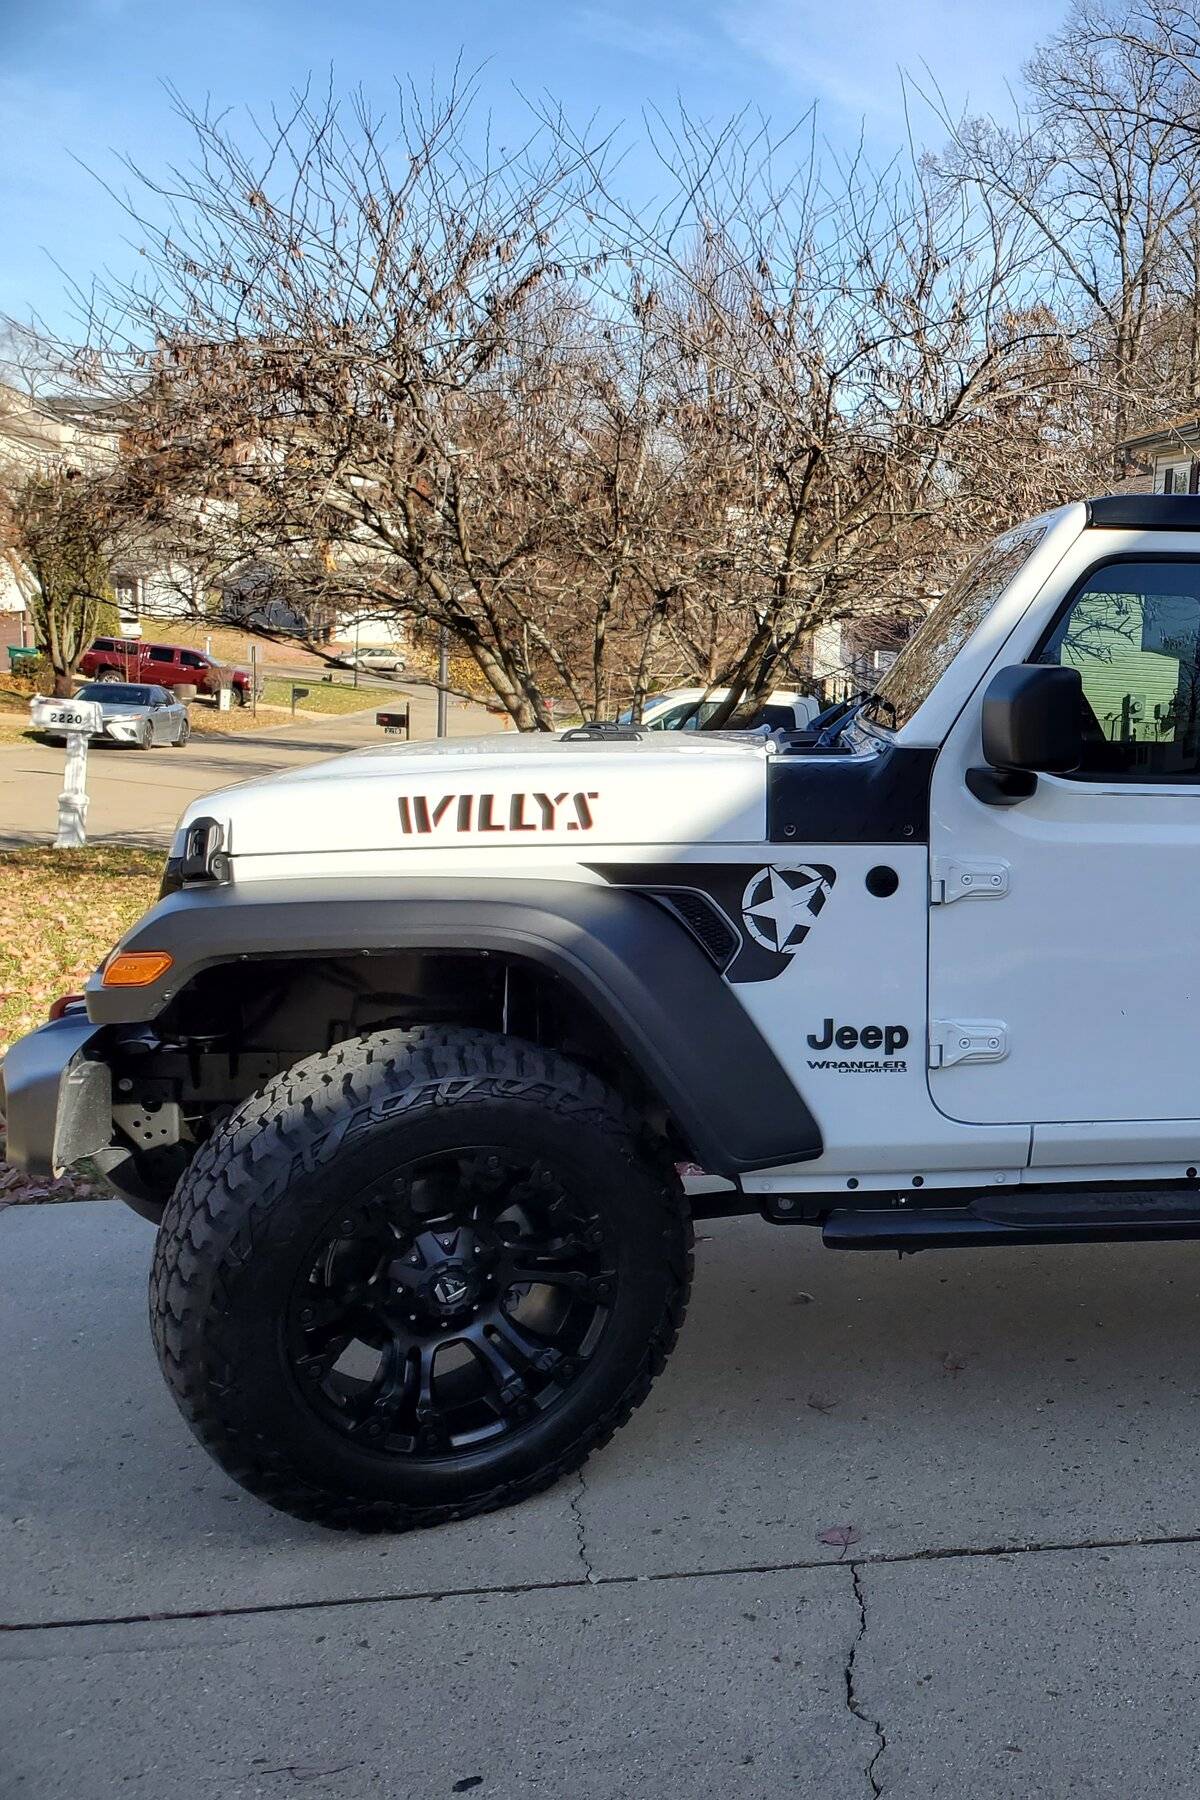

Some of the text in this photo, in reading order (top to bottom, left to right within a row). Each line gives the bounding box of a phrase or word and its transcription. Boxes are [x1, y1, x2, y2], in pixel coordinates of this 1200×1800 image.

[50, 713, 82, 724] 2220
[398, 792, 599, 834] WILLYS
[807, 1018, 909, 1055] Jeep
[806, 1060, 907, 1069] WRANGLER
